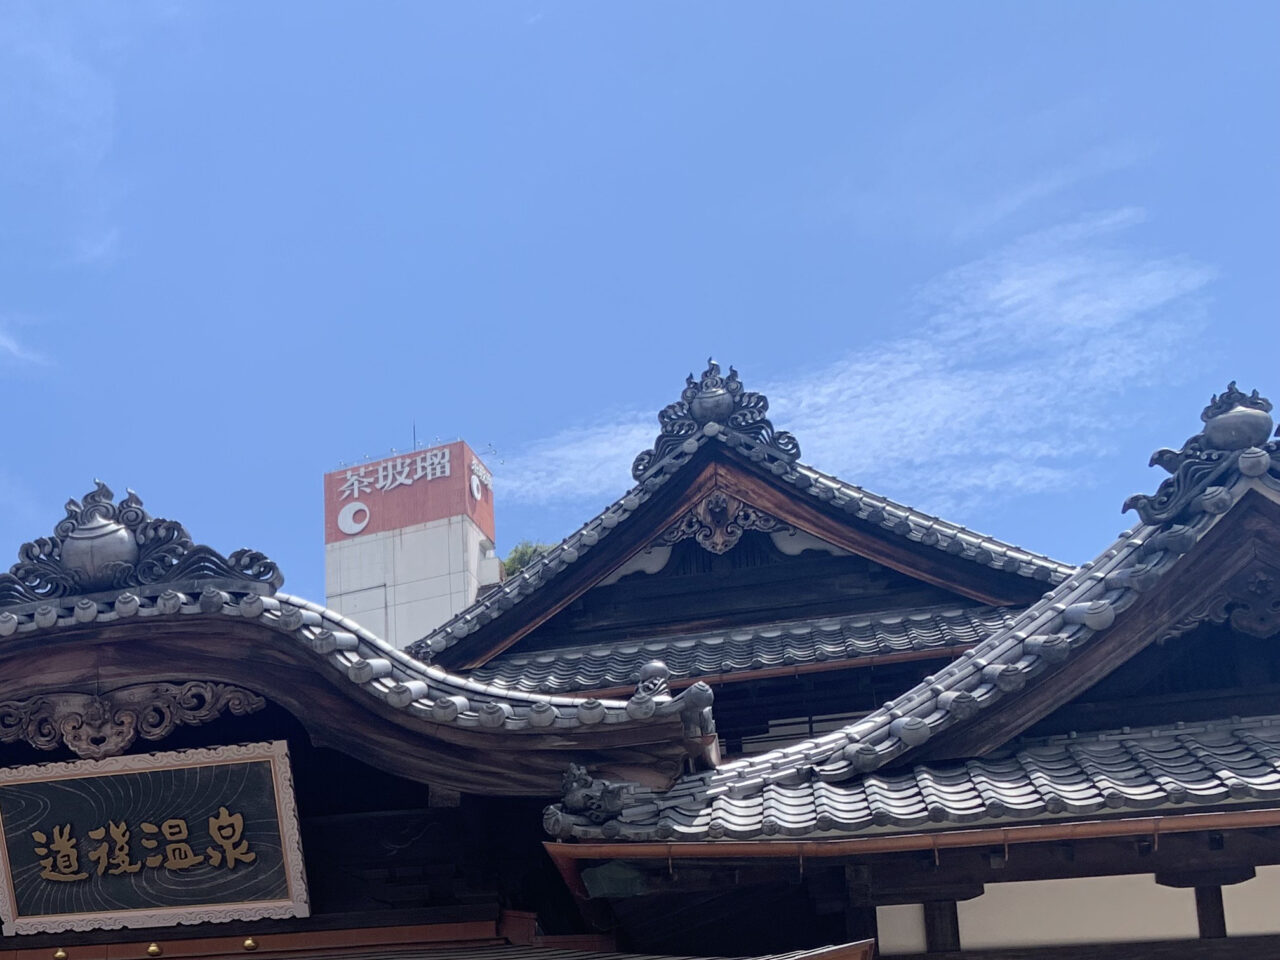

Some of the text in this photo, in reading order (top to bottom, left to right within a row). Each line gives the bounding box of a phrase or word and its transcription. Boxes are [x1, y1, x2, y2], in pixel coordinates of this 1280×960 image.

[336, 449, 451, 501] 茶玻瑠
[31, 805, 257, 883] 道後温泉
